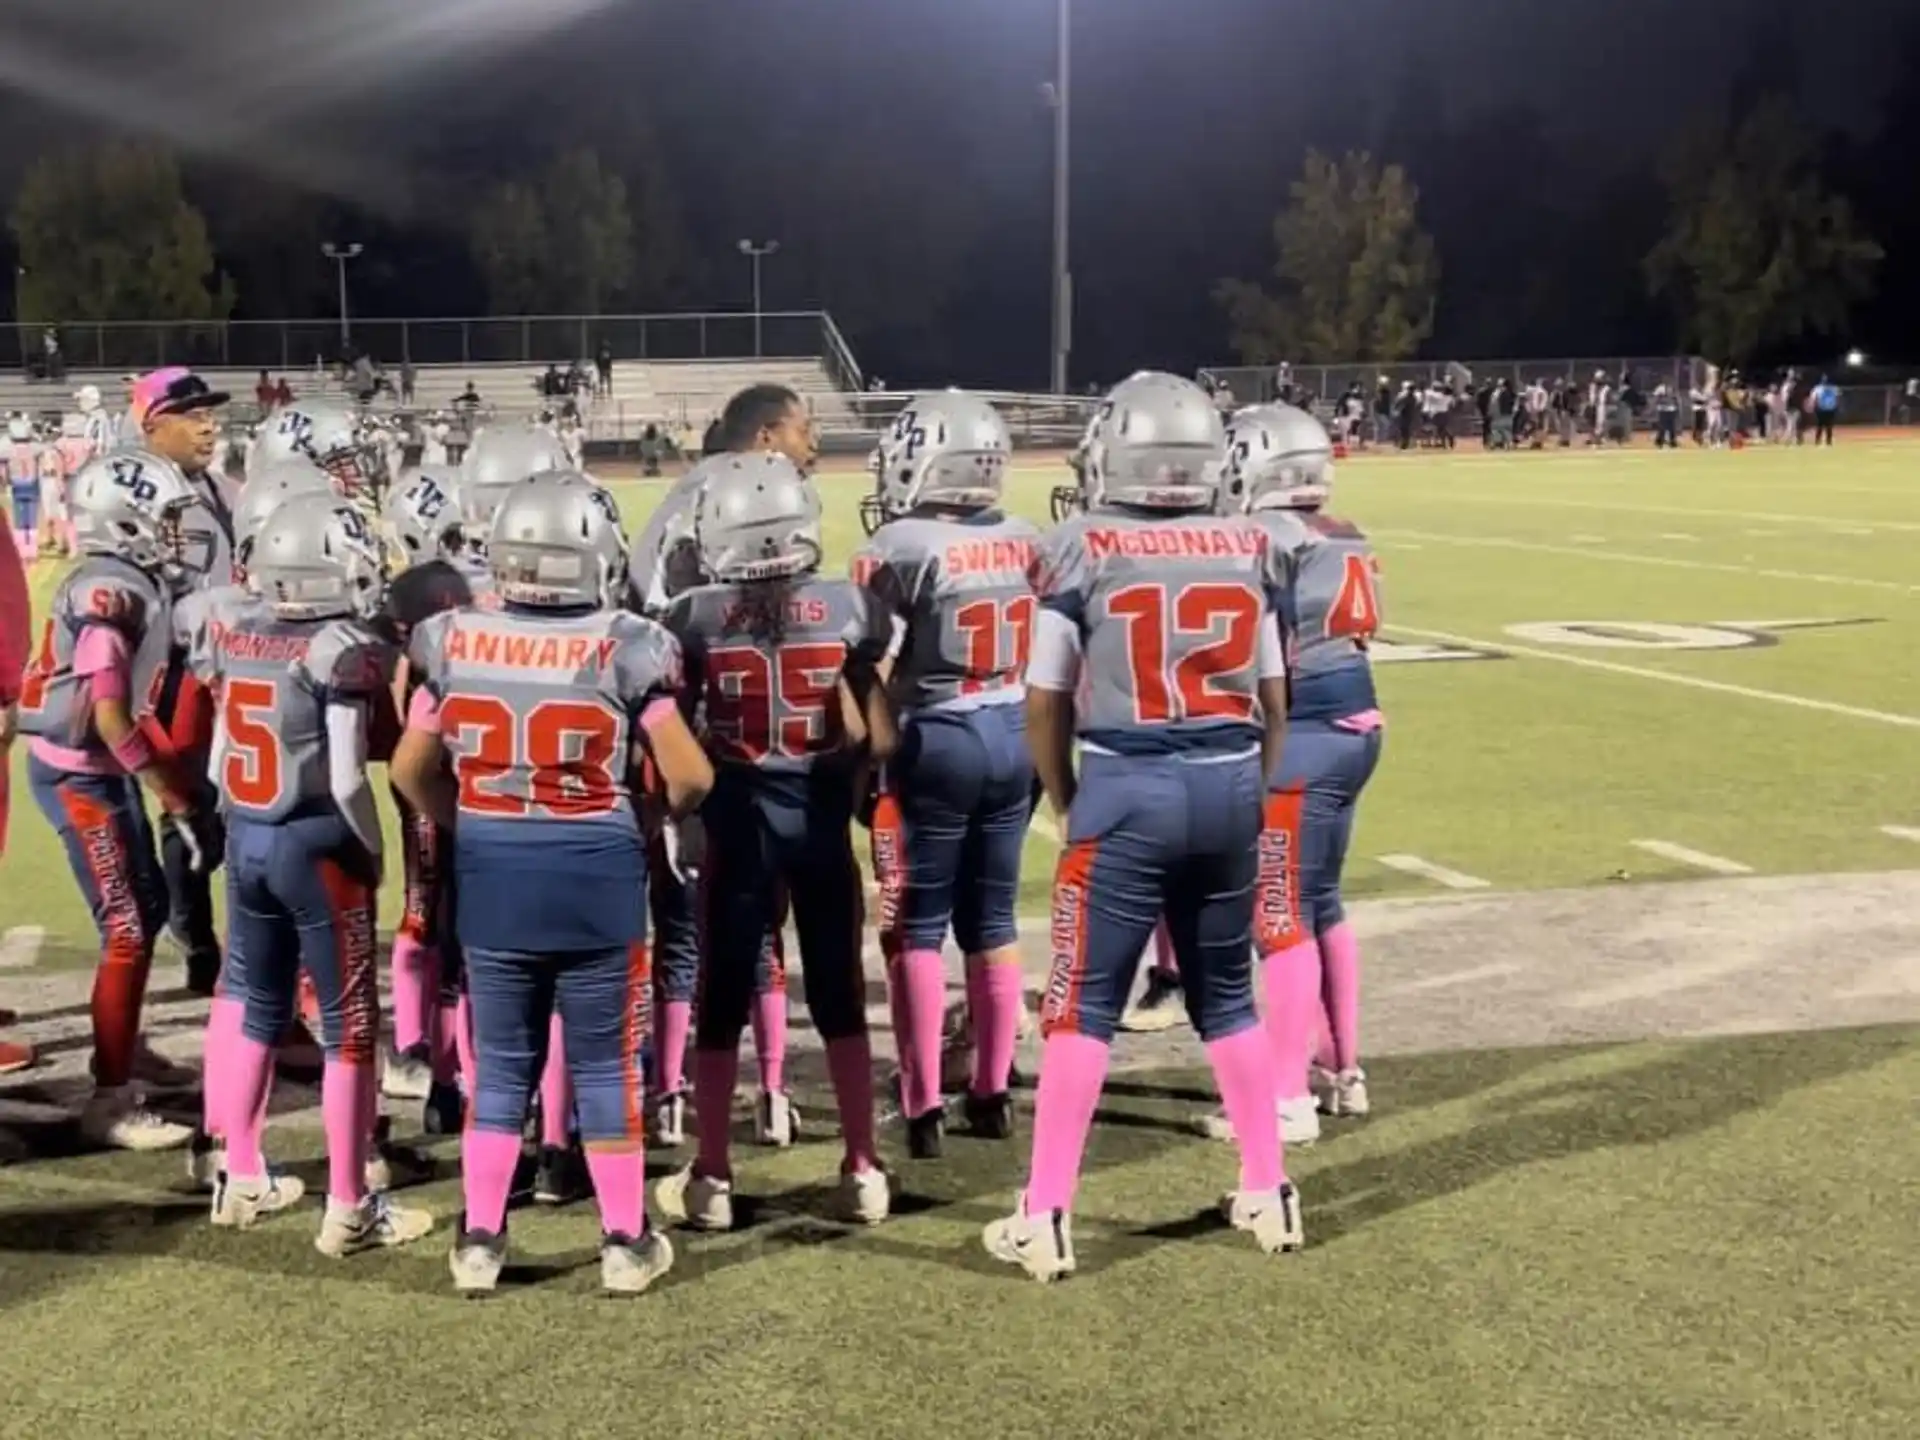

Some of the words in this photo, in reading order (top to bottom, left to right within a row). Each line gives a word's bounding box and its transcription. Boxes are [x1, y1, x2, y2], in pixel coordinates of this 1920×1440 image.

[446, 626, 618, 675] ANWARY
[706, 642, 847, 764] 95
[956, 595, 1038, 694] 11
[1105, 582, 1264, 724] 12
[223, 678, 283, 810] 5
[438, 693, 622, 818] 28
